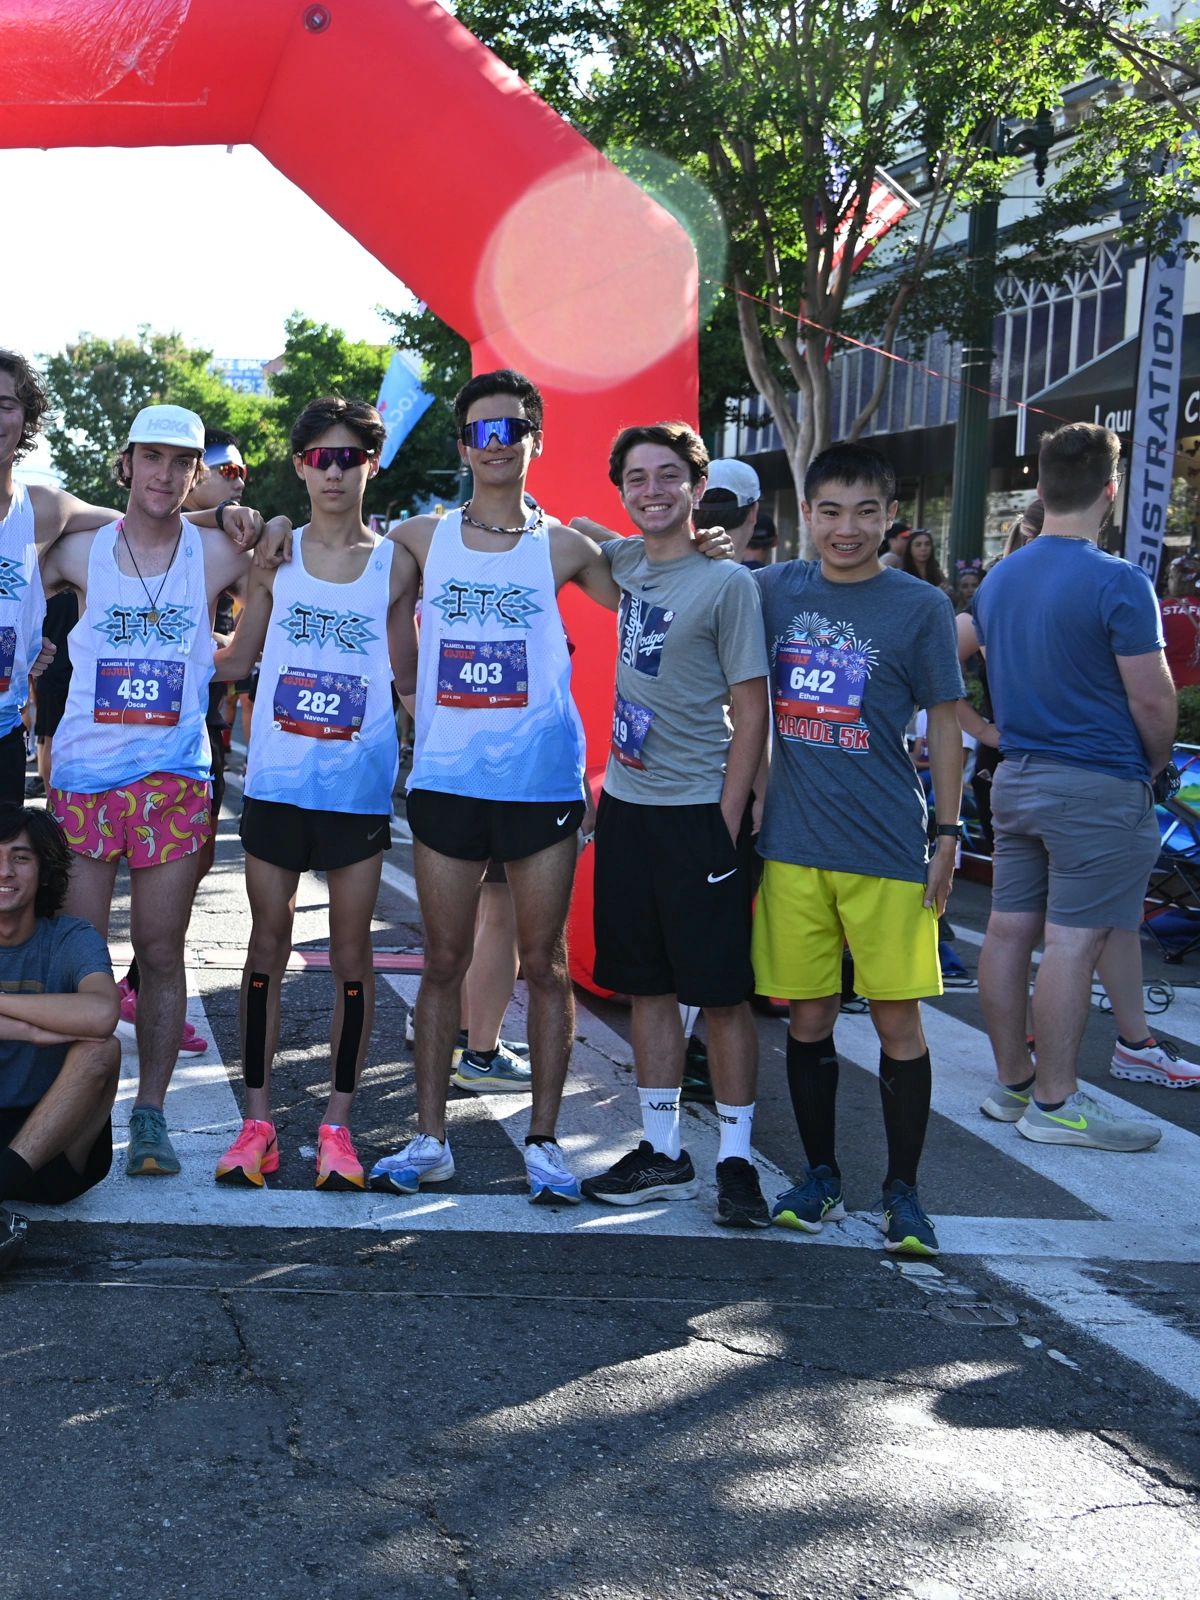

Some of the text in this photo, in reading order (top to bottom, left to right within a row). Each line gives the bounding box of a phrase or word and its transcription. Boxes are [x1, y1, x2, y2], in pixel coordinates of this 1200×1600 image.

[147, 418, 190, 435] HOKA
[1138, 284, 1174, 588] GISTRATION
[459, 662, 503, 684] 403
[789, 666, 836, 694] 642
[117, 678, 159, 701] 433
[798, 692, 820, 701] Ethan
[296, 689, 341, 715] 282
[303, 713, 329, 723] Naveen
[613, 716, 628, 743] 19
[778, 715, 870, 749] ARADE 5K
[648, 1101, 679, 1111] VAN
